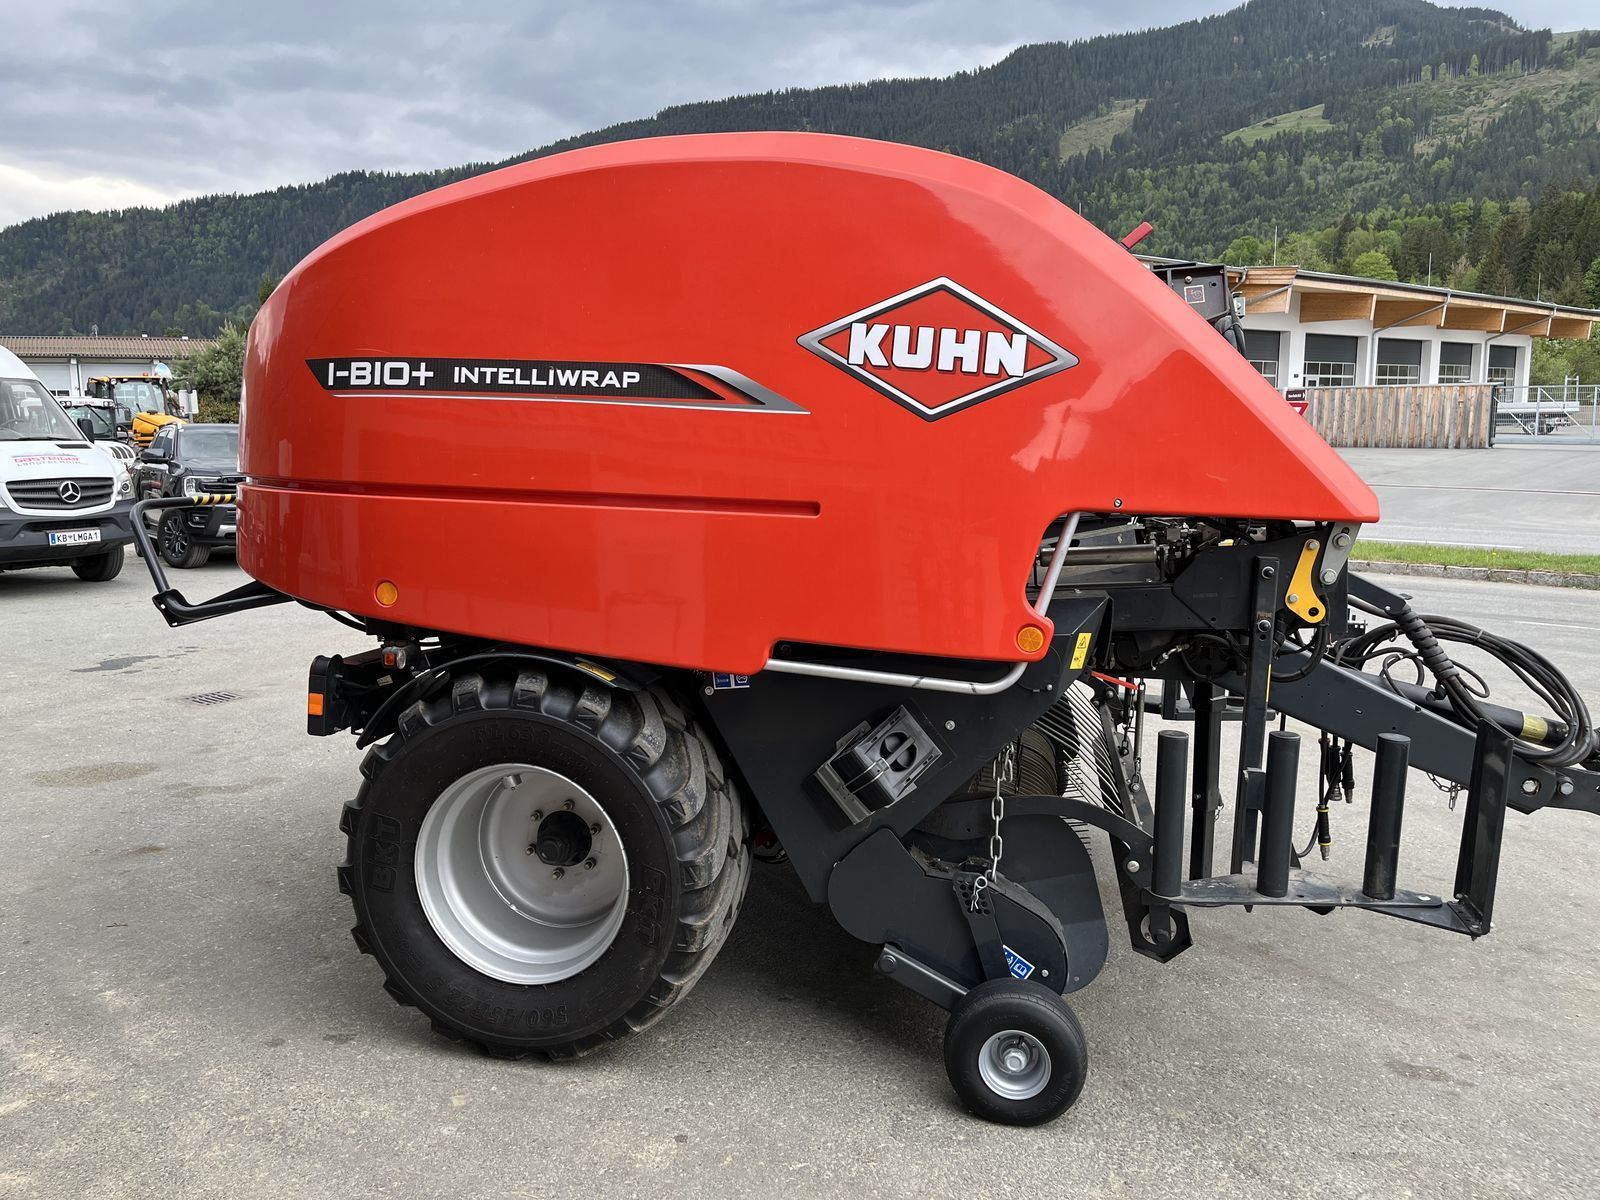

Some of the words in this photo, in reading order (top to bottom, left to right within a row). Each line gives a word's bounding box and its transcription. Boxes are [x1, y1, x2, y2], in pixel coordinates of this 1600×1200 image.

[848, 322, 1028, 378] KUHN
[328, 361, 434, 386] I-BIO+
[453, 366, 640, 388] INTELLIWRAP
[57, 534, 68, 543] KB
